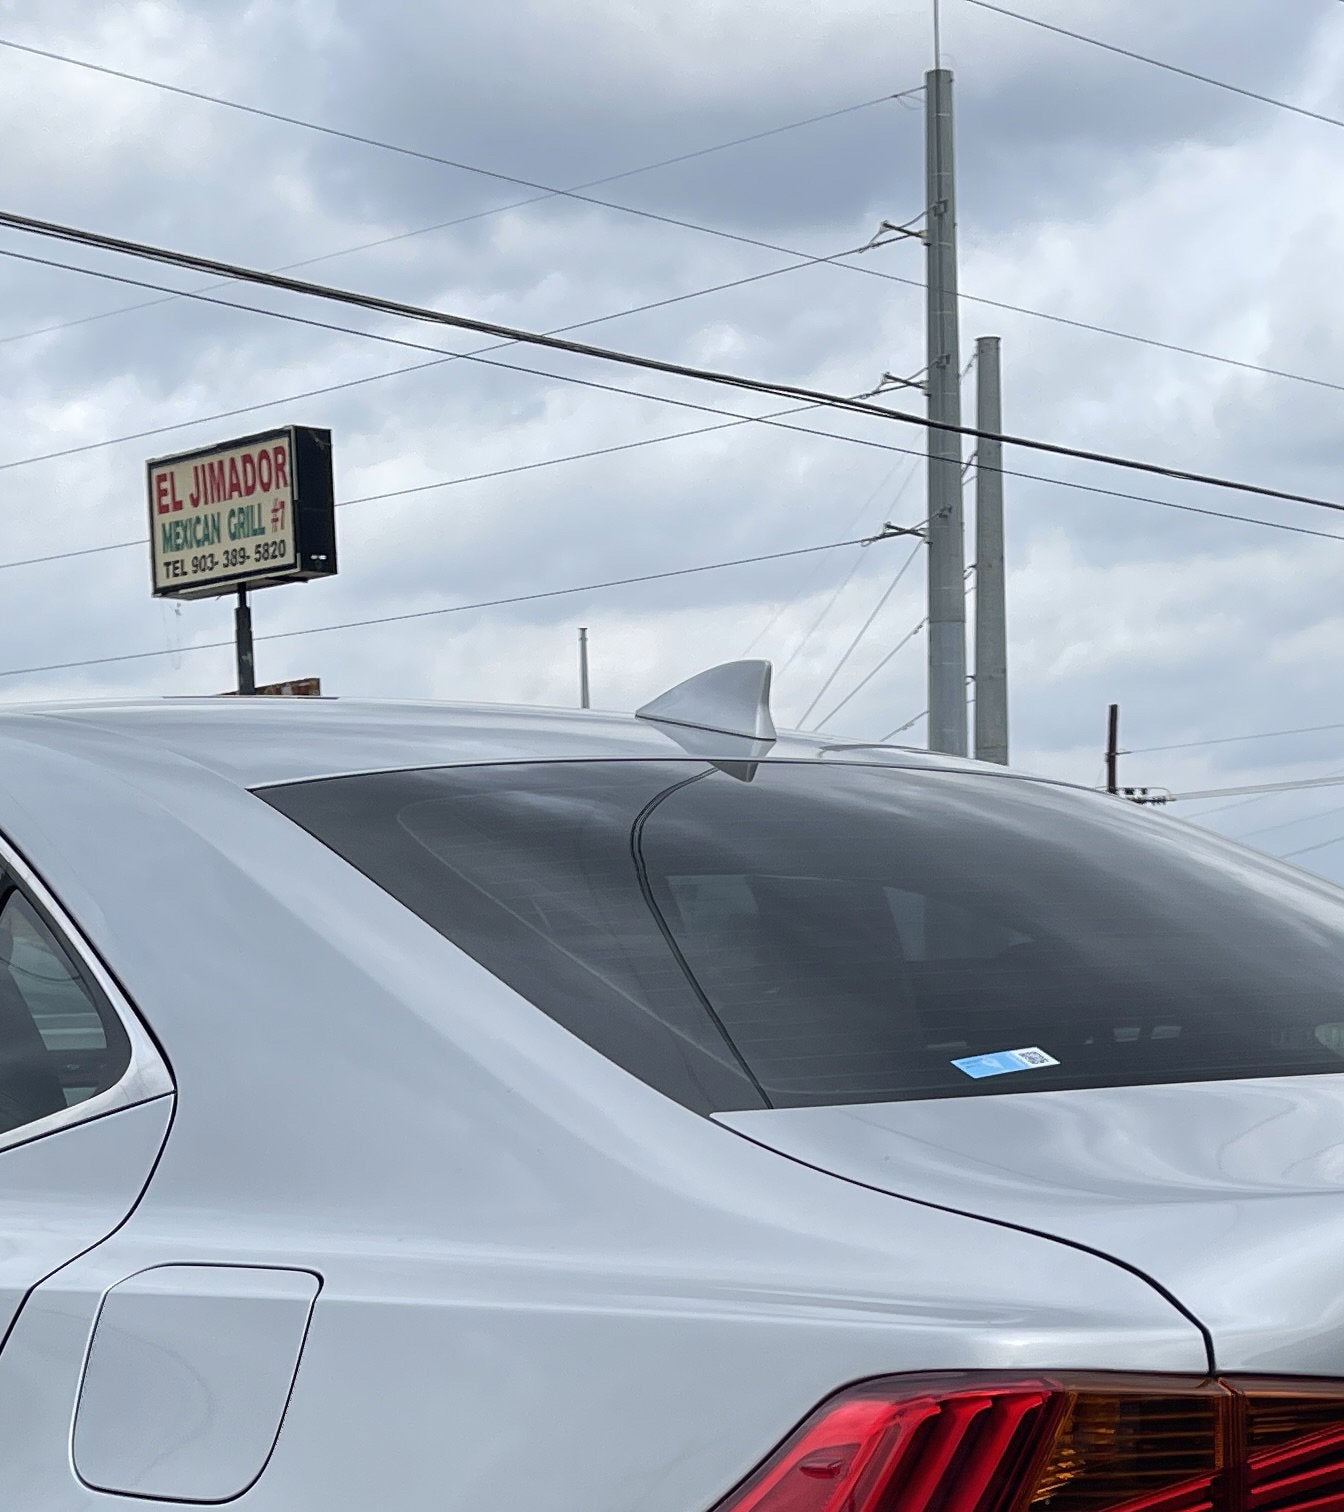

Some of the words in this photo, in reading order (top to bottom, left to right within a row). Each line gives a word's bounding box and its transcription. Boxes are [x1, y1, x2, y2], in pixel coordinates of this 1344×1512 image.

[156, 472, 183, 515] EL
[189, 445, 288, 508] JIMADOR
[162, 512, 221, 553] MEXICAN
[227, 503, 265, 541] GRILL
[164, 559, 188, 579] TEL
[254, 539, 286, 562] 5820
